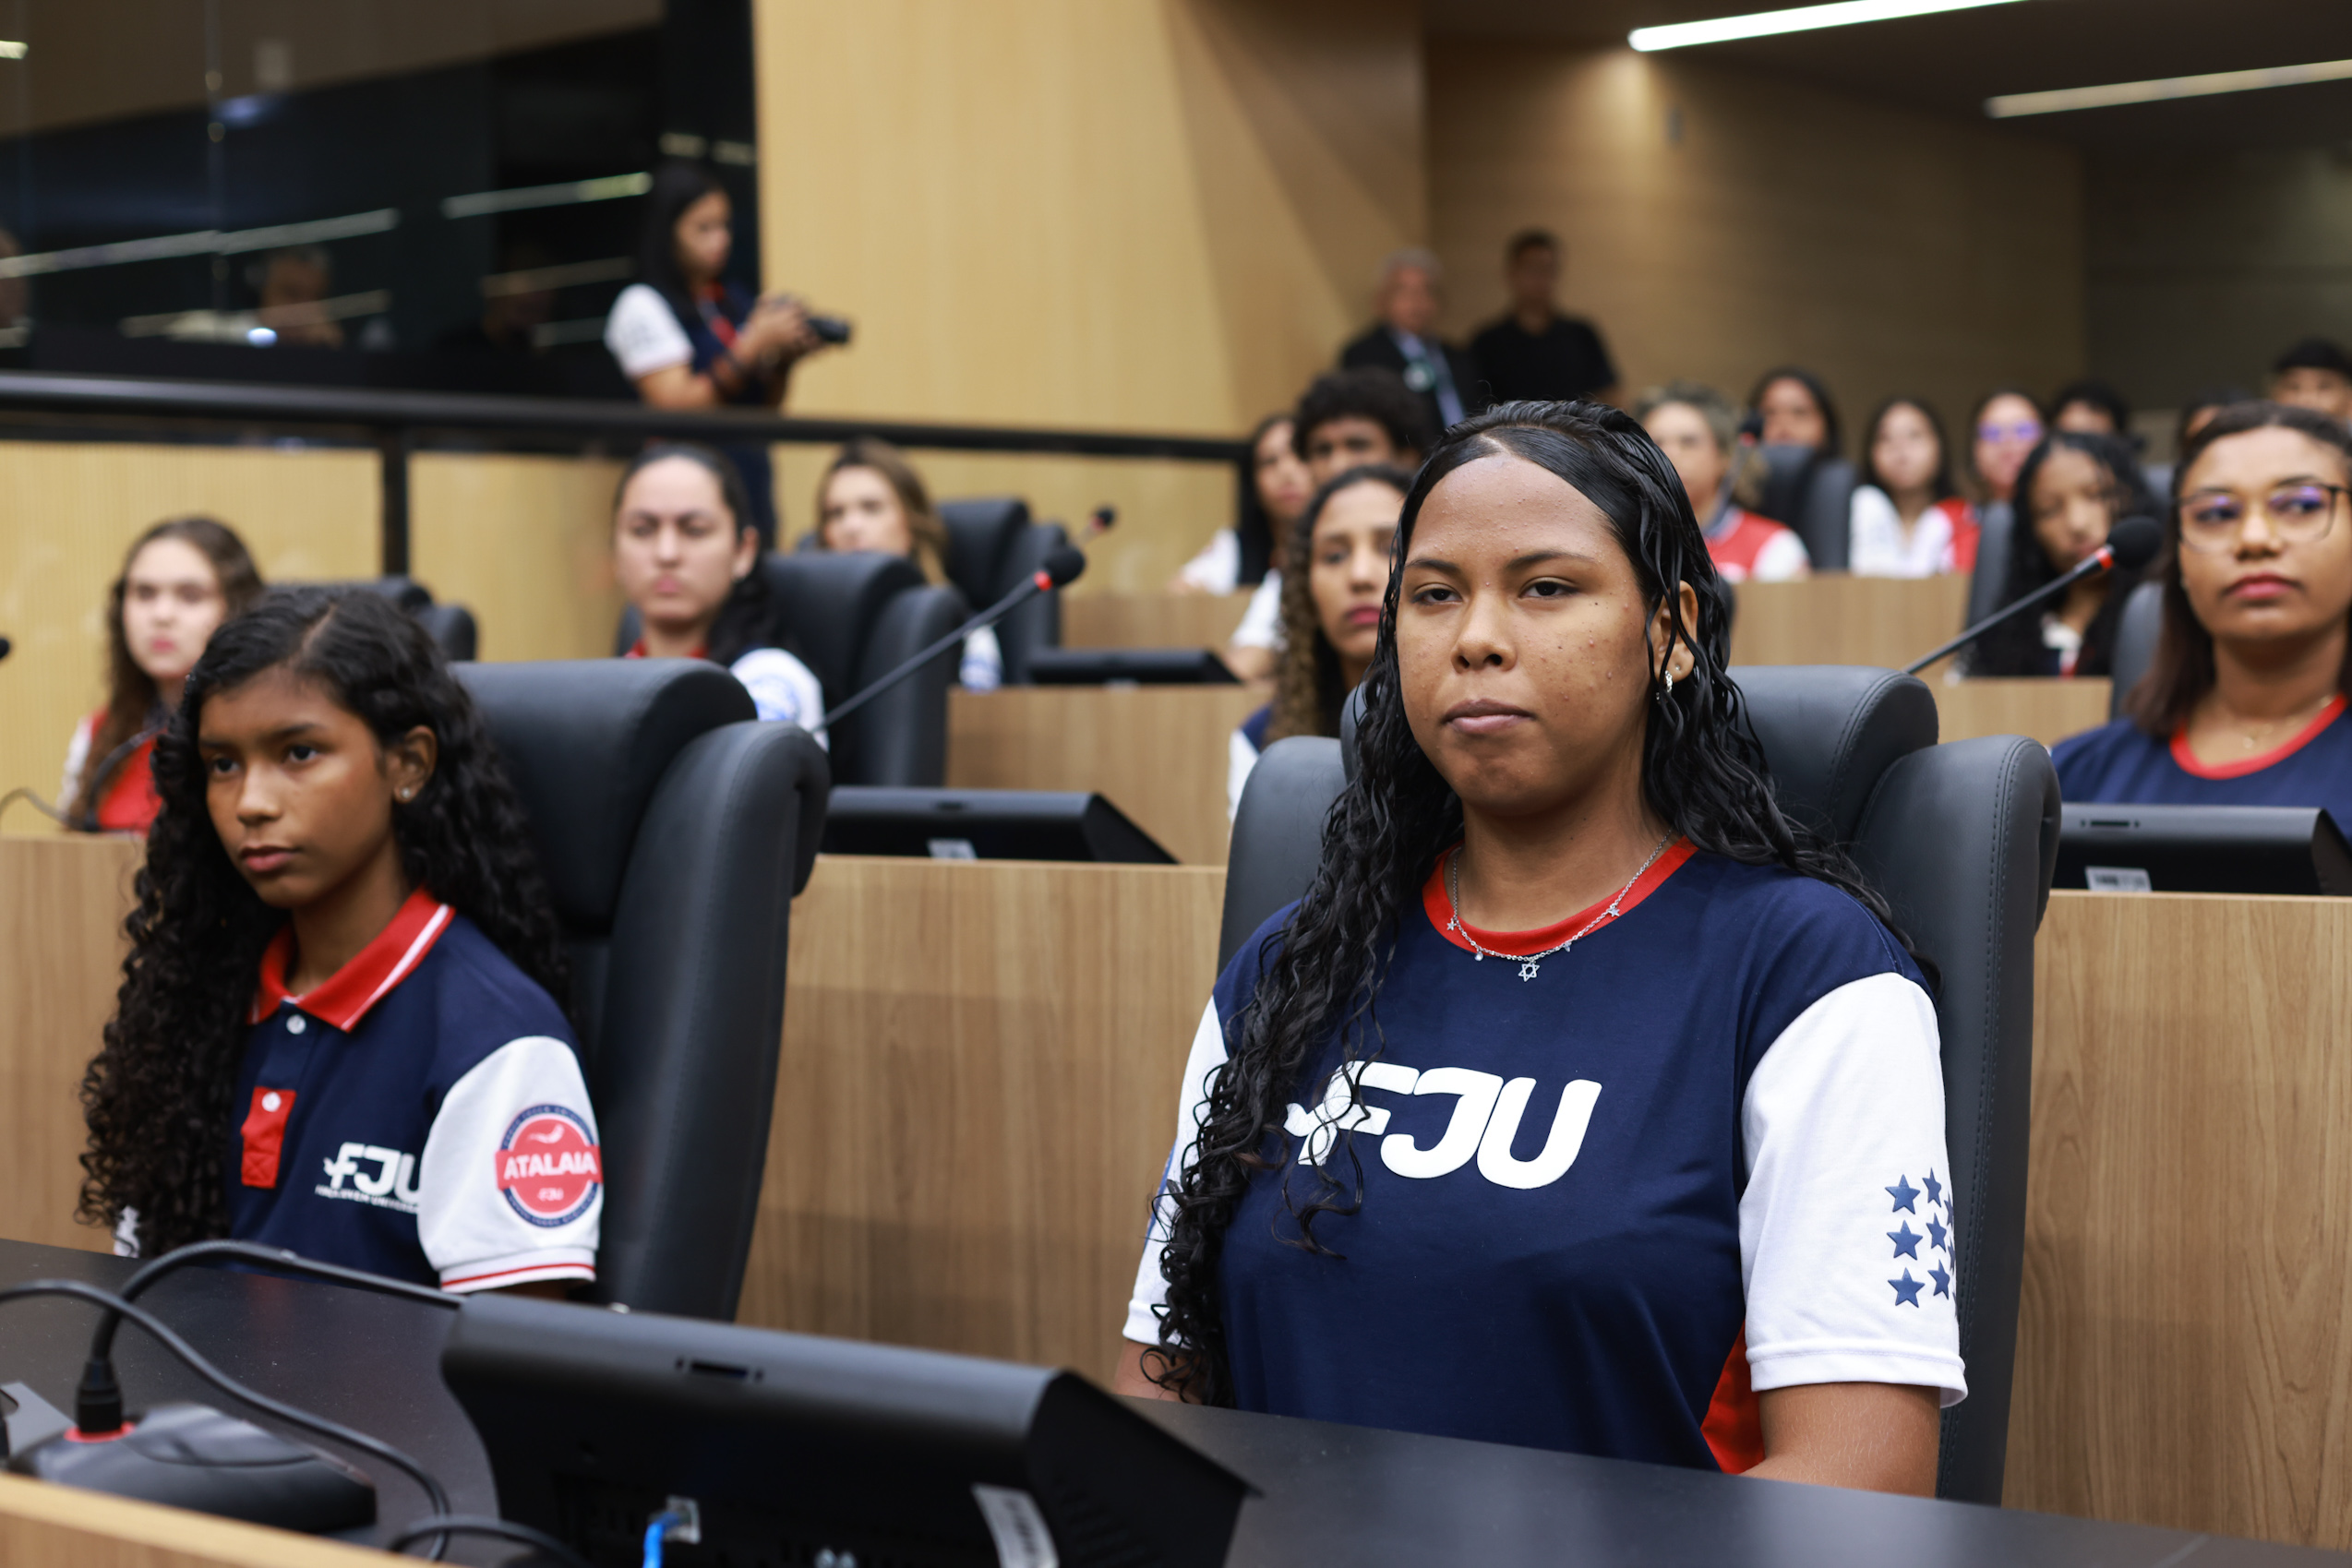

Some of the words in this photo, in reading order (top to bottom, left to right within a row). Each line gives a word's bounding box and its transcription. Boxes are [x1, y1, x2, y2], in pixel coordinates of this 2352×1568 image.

[1284, 1060, 1602, 1190] FJU
[323, 1142, 420, 1203] FJU
[503, 1151, 598, 1180] ATALAIA
